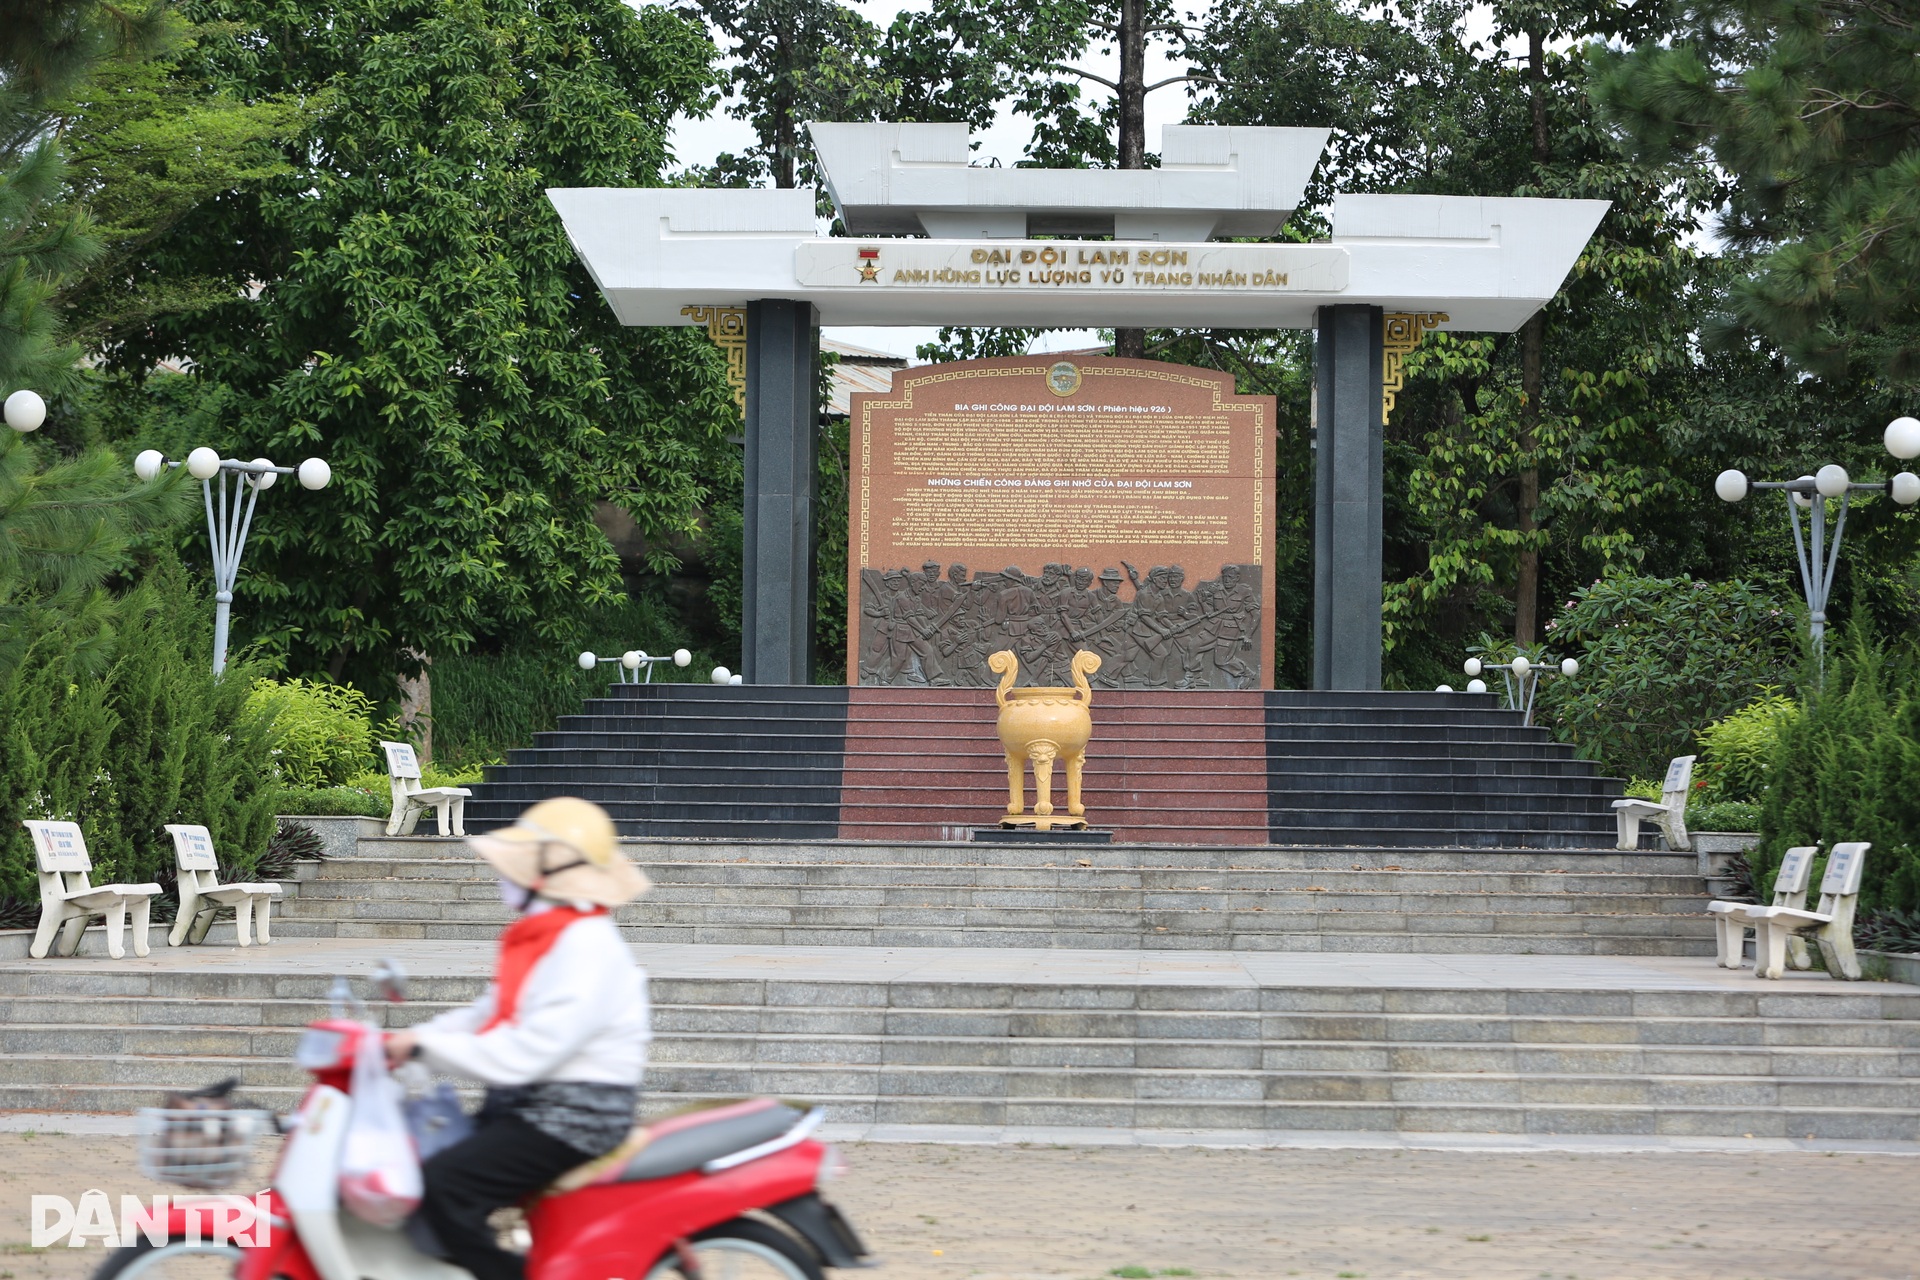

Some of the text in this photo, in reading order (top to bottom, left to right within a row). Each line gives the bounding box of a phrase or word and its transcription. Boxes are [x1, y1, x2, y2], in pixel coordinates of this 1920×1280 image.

[971, 247, 1188, 267] ĐẠI ĐỘI LAM SƠN
[894, 267, 1288, 286] ANH HÙNG LỰC LƯỢNG VŨ TRANG NHÂN DÂN
[990, 403, 1018, 411] CÔNG
[928, 478, 961, 486] NHỮNG
[963, 477, 992, 486] CHIẾN
[994, 478, 1022, 486] CÔNG
[1094, 478, 1114, 487] CỦA
